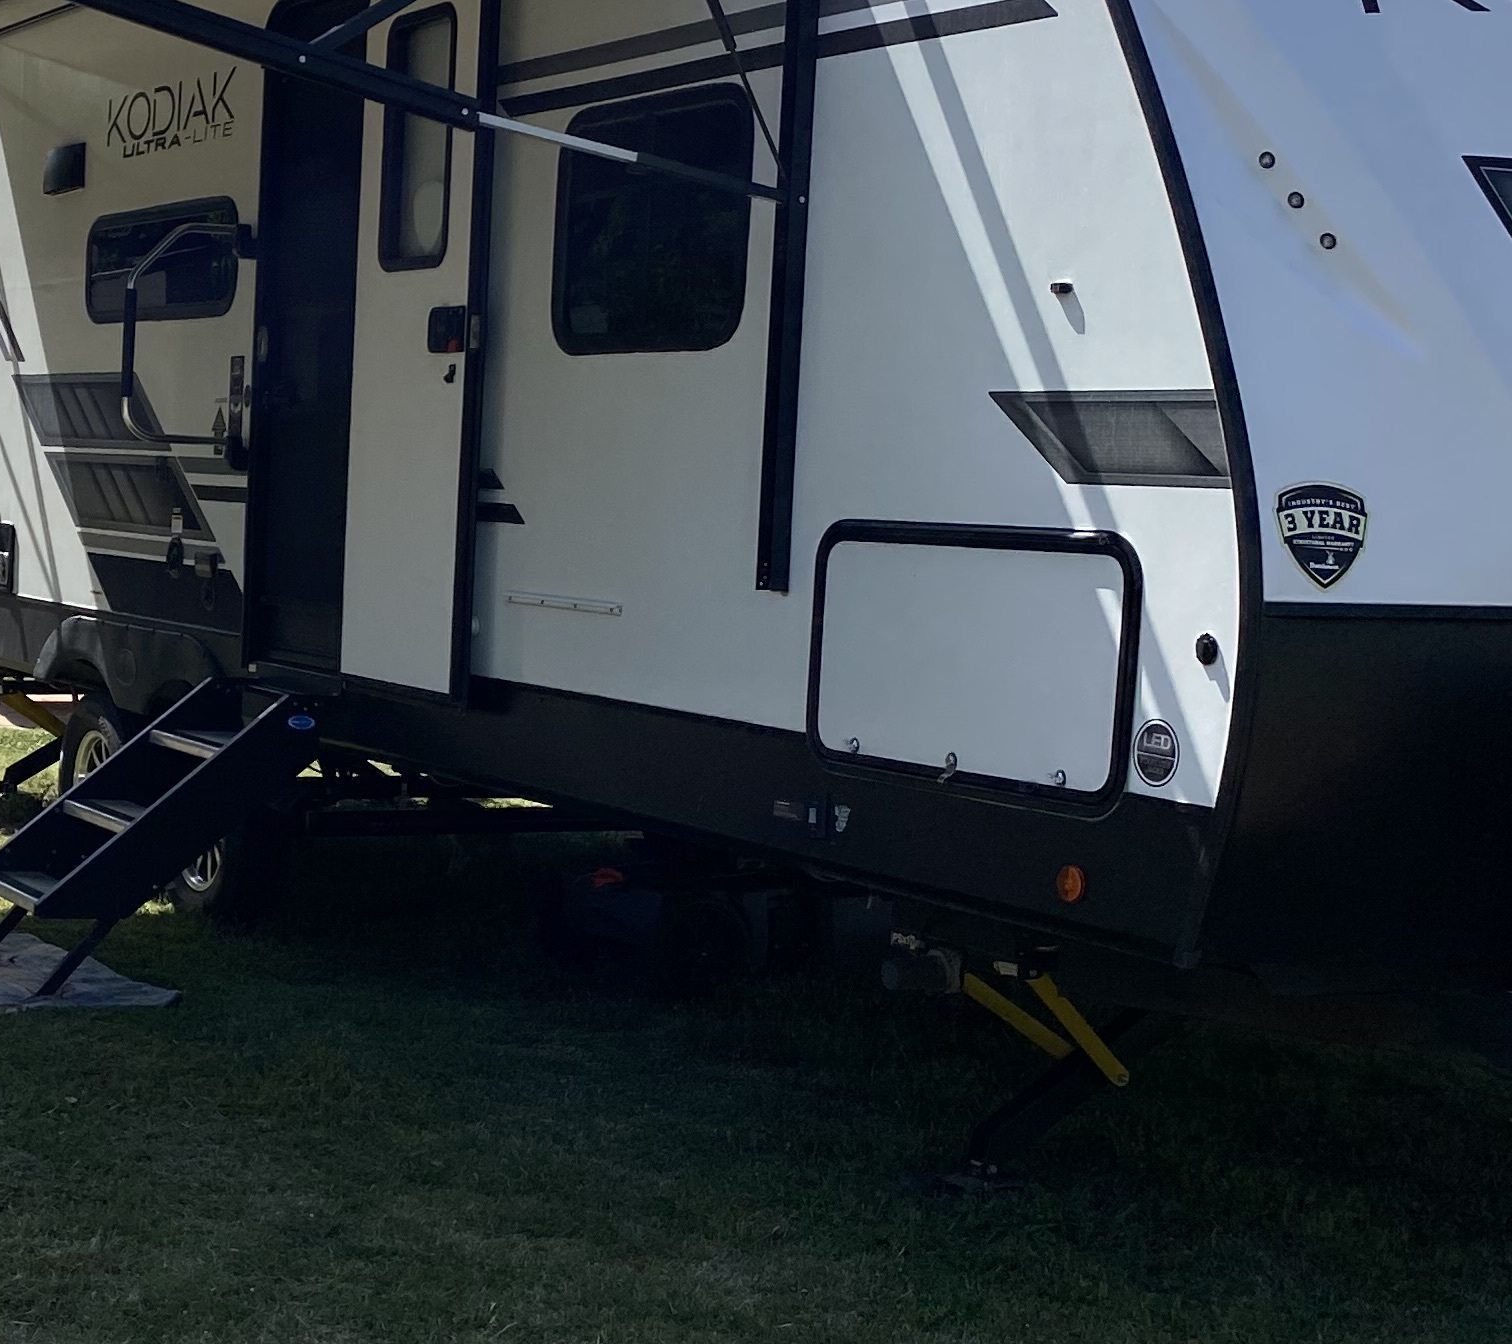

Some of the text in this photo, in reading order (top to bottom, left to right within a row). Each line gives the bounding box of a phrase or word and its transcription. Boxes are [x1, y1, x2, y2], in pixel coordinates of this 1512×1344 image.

[107, 66, 237, 147] KODIAK
[123, 120, 236, 158] ULTRA-LITE
[1284, 510, 1361, 535] 3 YEAR
[1144, 732, 1172, 749] LED
